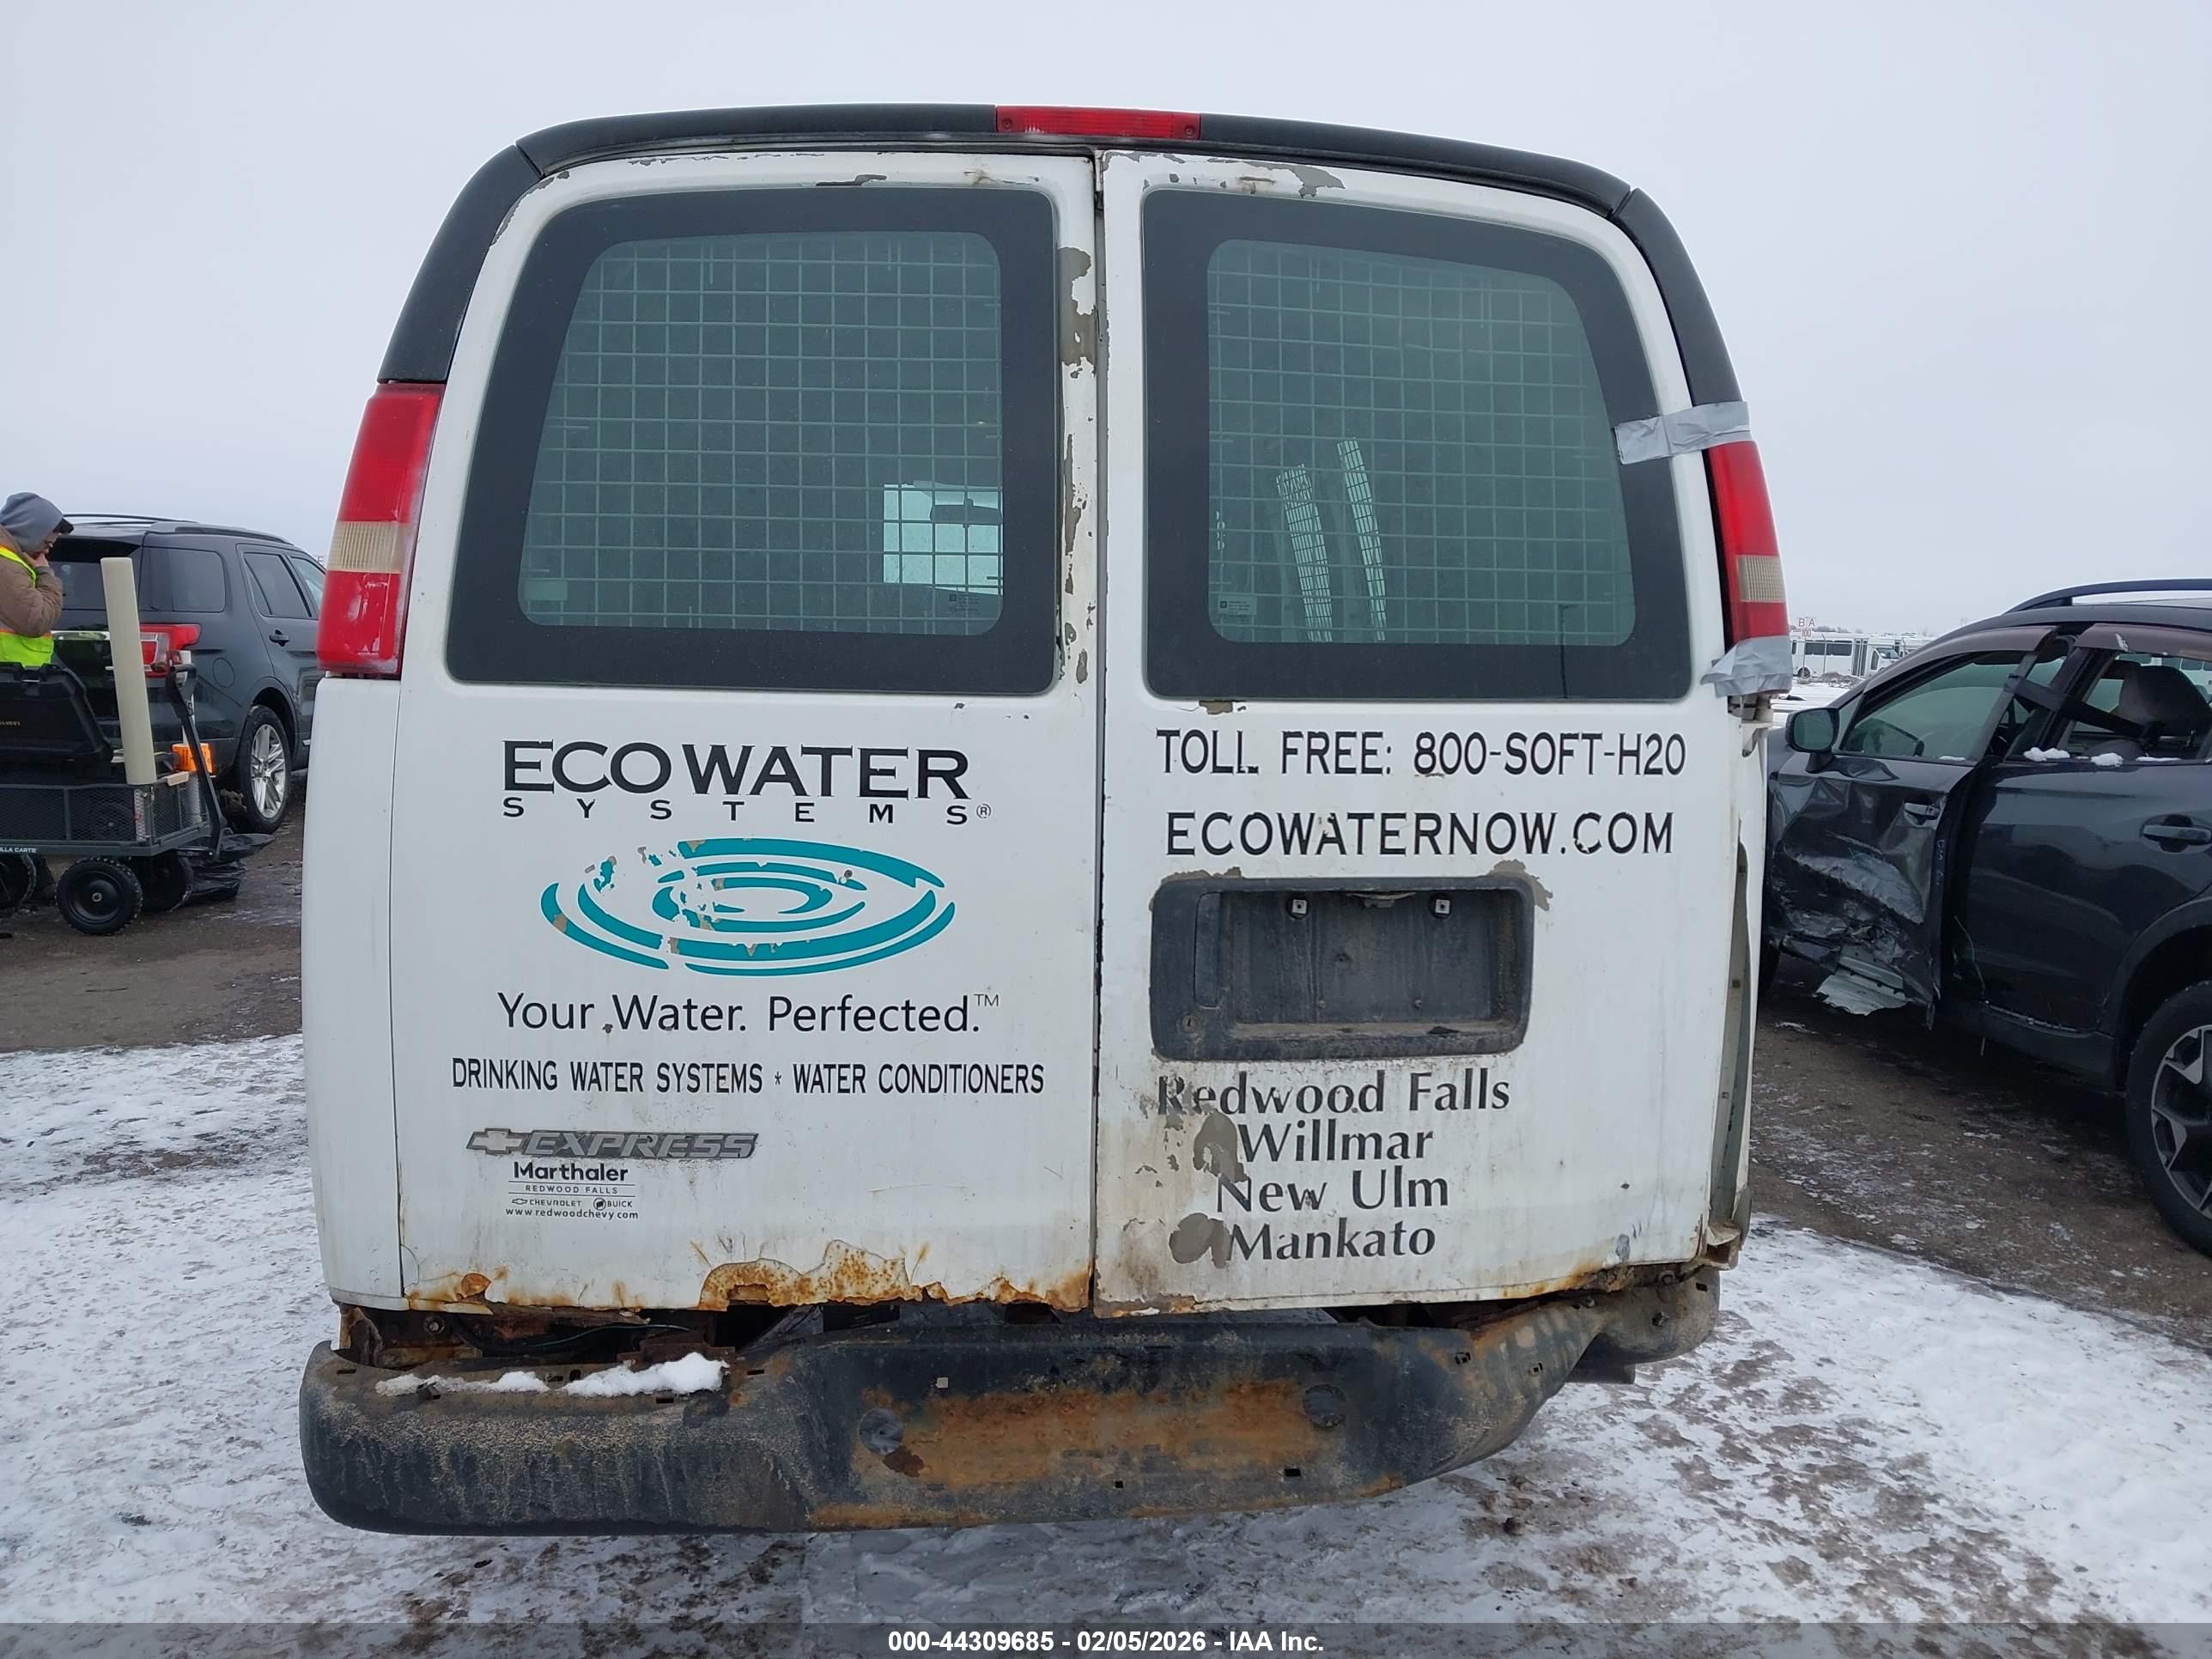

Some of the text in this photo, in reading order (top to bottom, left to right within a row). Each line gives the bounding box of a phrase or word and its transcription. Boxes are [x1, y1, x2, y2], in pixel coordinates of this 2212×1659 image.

[501, 738, 971, 800] ECOWATER
[1156, 729, 1259, 775] TOLL
[1281, 730, 1392, 775] FREE:
[1166, 811, 1674, 856] ECOWATERNOW.COM
[497, 992, 595, 1030] Your
[611, 994, 746, 1032] Water.
[452, 1057, 558, 1091] DRINKING
[570, 1060, 644, 1092] WATER
[656, 1062, 763, 1094] SYSTEMS
[793, 1064, 866, 1094] WATER
[878, 1064, 1044, 1094] CONDITIONERS
[1158, 1067, 1511, 1115] Redwood Falls
[525, 1132, 756, 1158] EXPRESS
[1237, 1119, 1434, 1163] Willmar
[514, 1161, 629, 1182] Marthaler
[525, 1184, 618, 1194] REDWOOD FALLS
[1217, 1165, 1449, 1213] New Ulm
[528, 1199, 582, 1207] CHEVROLET
[1227, 1217, 1437, 1261] Mankato
